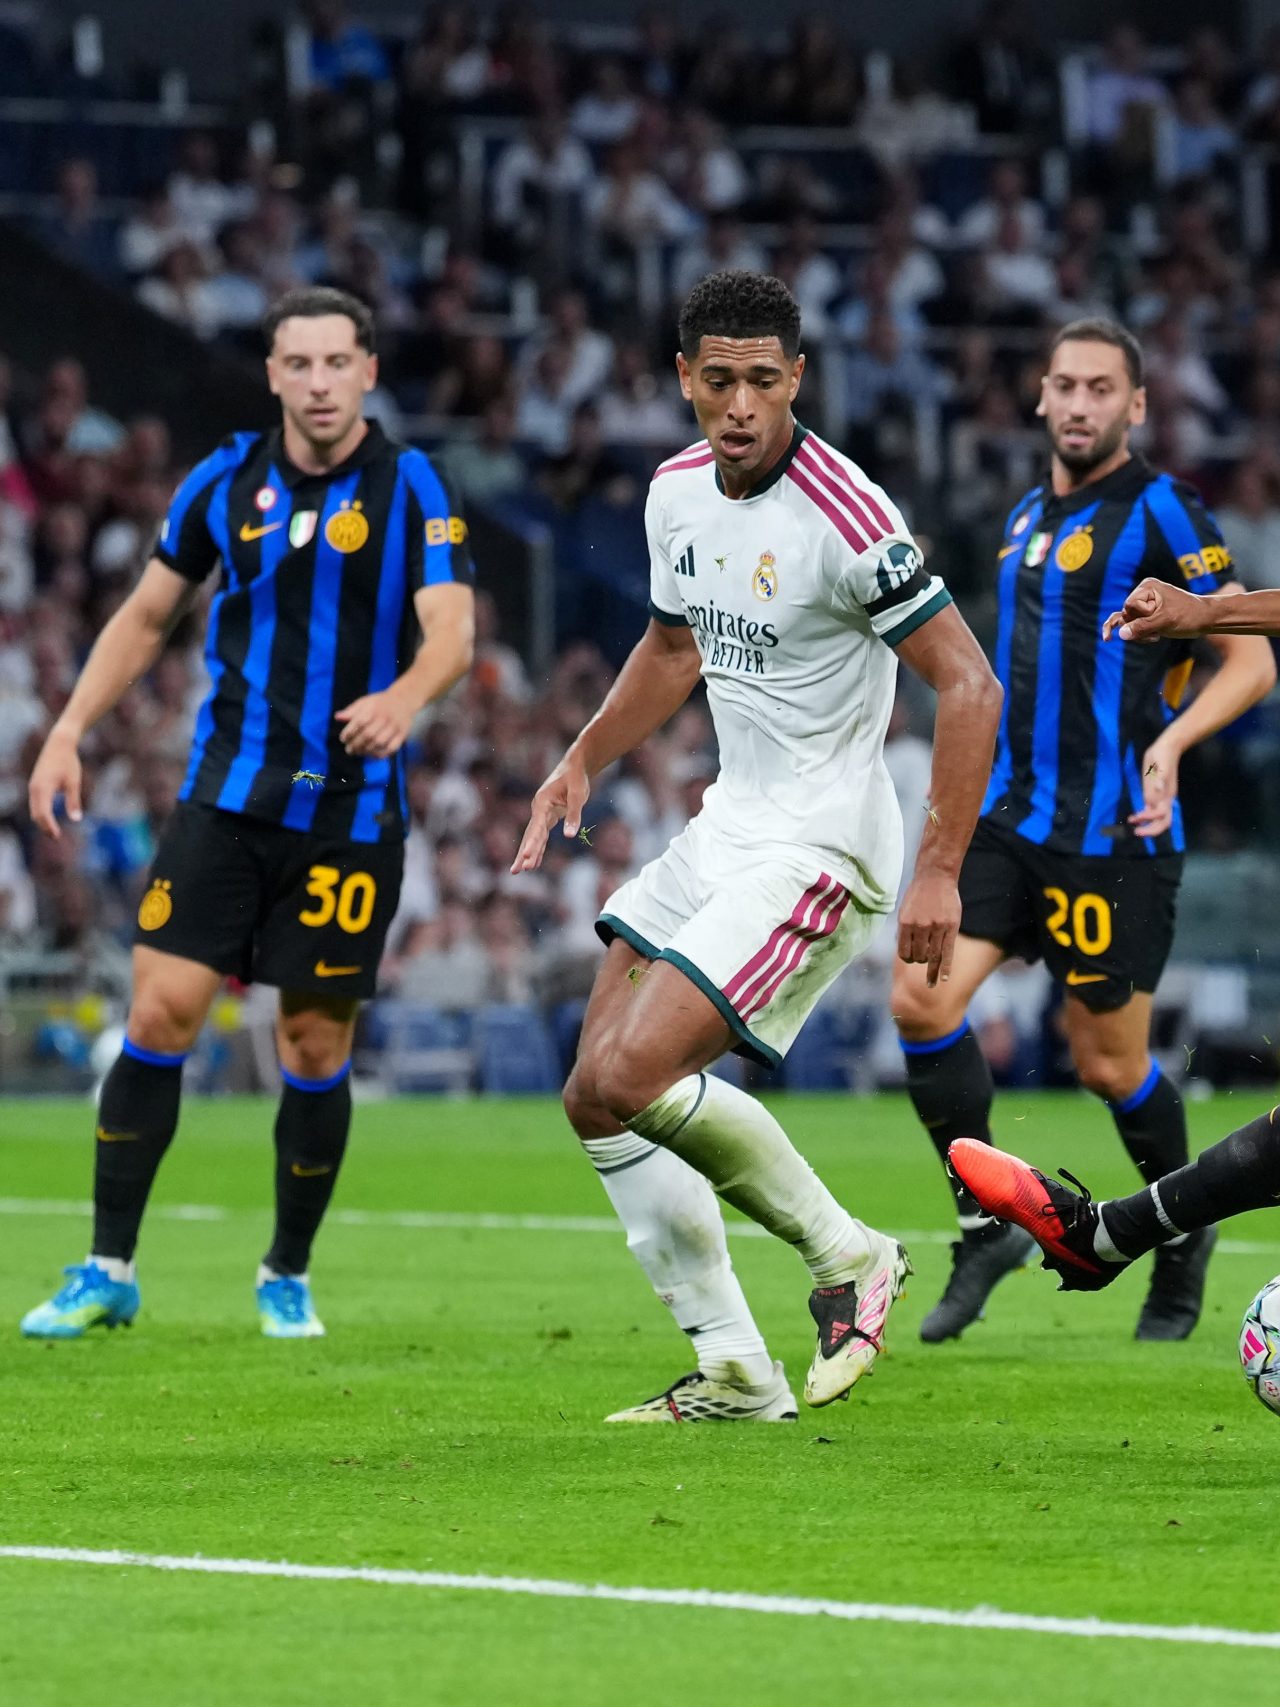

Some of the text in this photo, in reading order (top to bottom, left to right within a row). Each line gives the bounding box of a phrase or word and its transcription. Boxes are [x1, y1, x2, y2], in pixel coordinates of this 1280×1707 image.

[682, 599, 779, 648] mirates
[711, 637, 764, 674] BETTER
[299, 865, 376, 934] 30
[1043, 886, 1112, 956] 20
